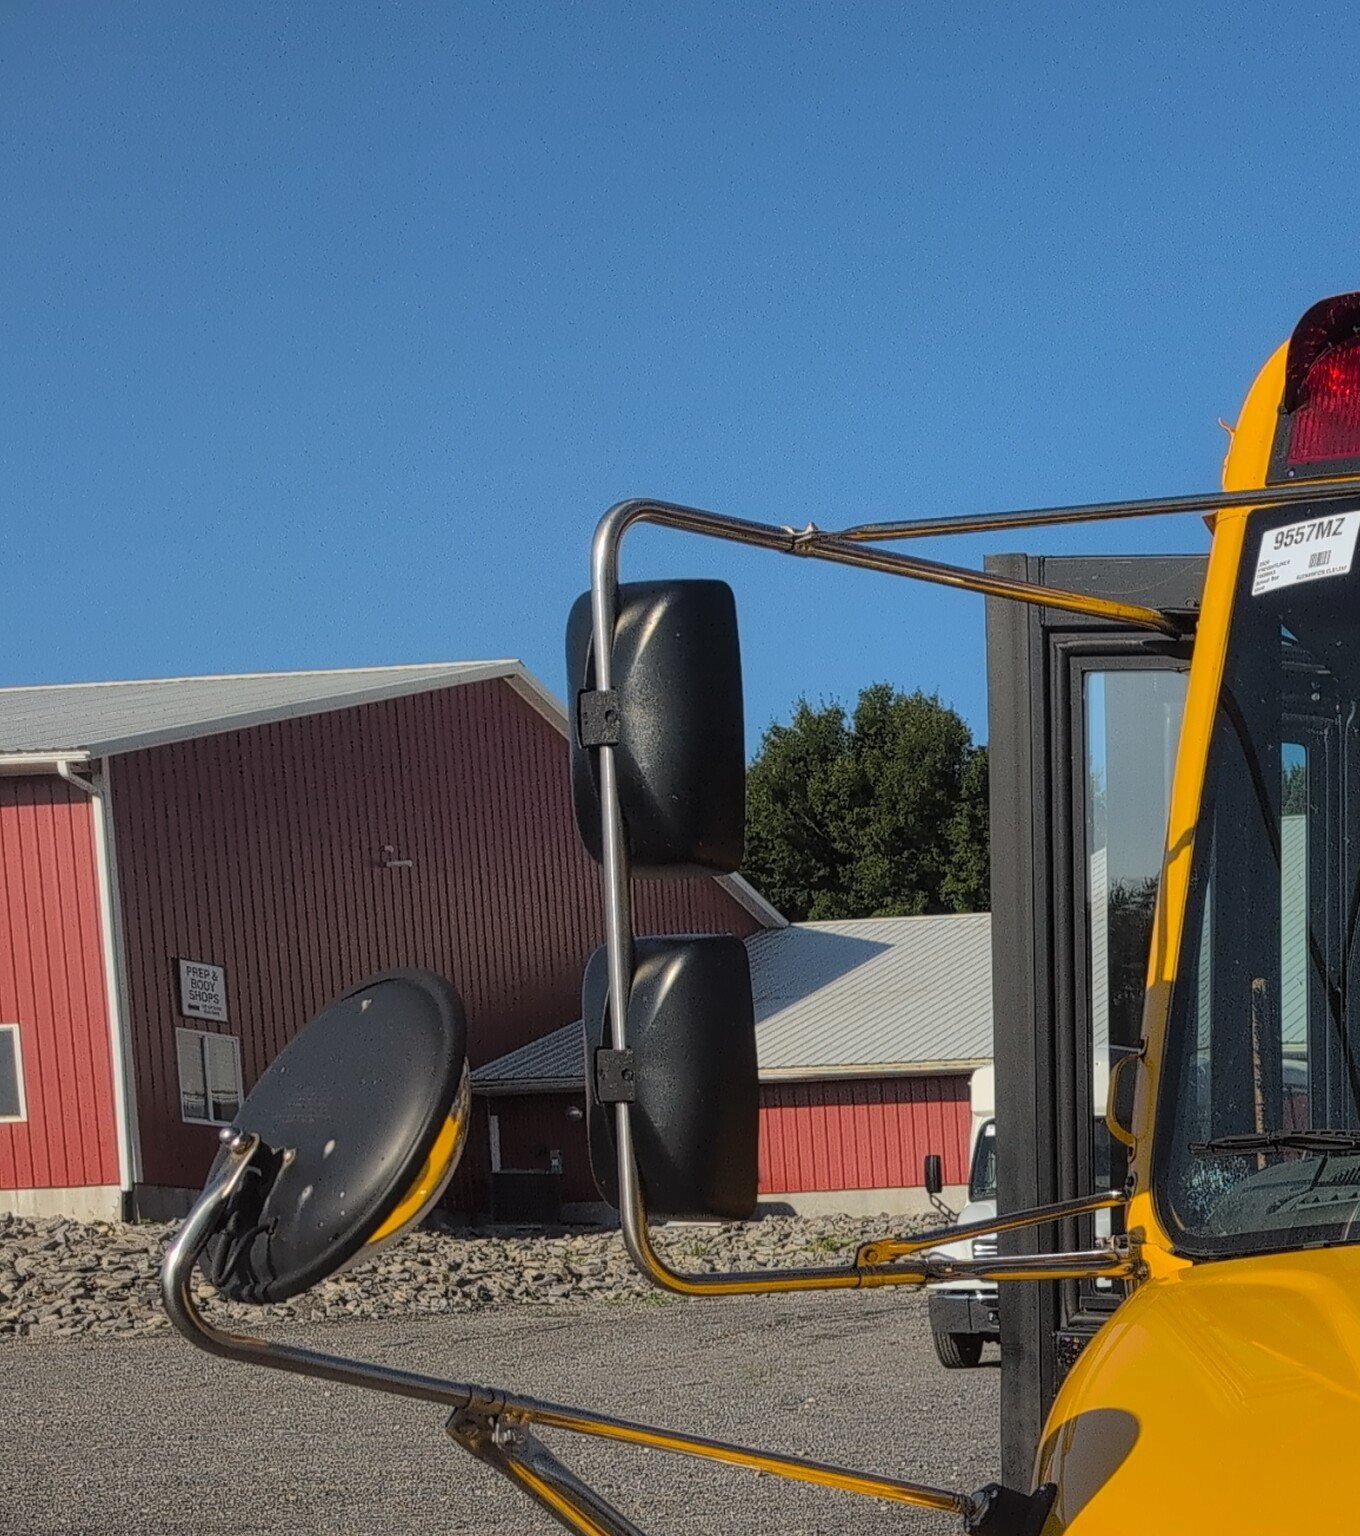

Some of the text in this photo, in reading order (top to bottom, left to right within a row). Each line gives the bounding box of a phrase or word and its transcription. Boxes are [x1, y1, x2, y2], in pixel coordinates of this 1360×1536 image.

[1273, 516, 1347, 551] 9557MZ
[186, 965, 219, 982] PREP &
[190, 978, 216, 993] BODY
[188, 989, 220, 1005] SHOPS
